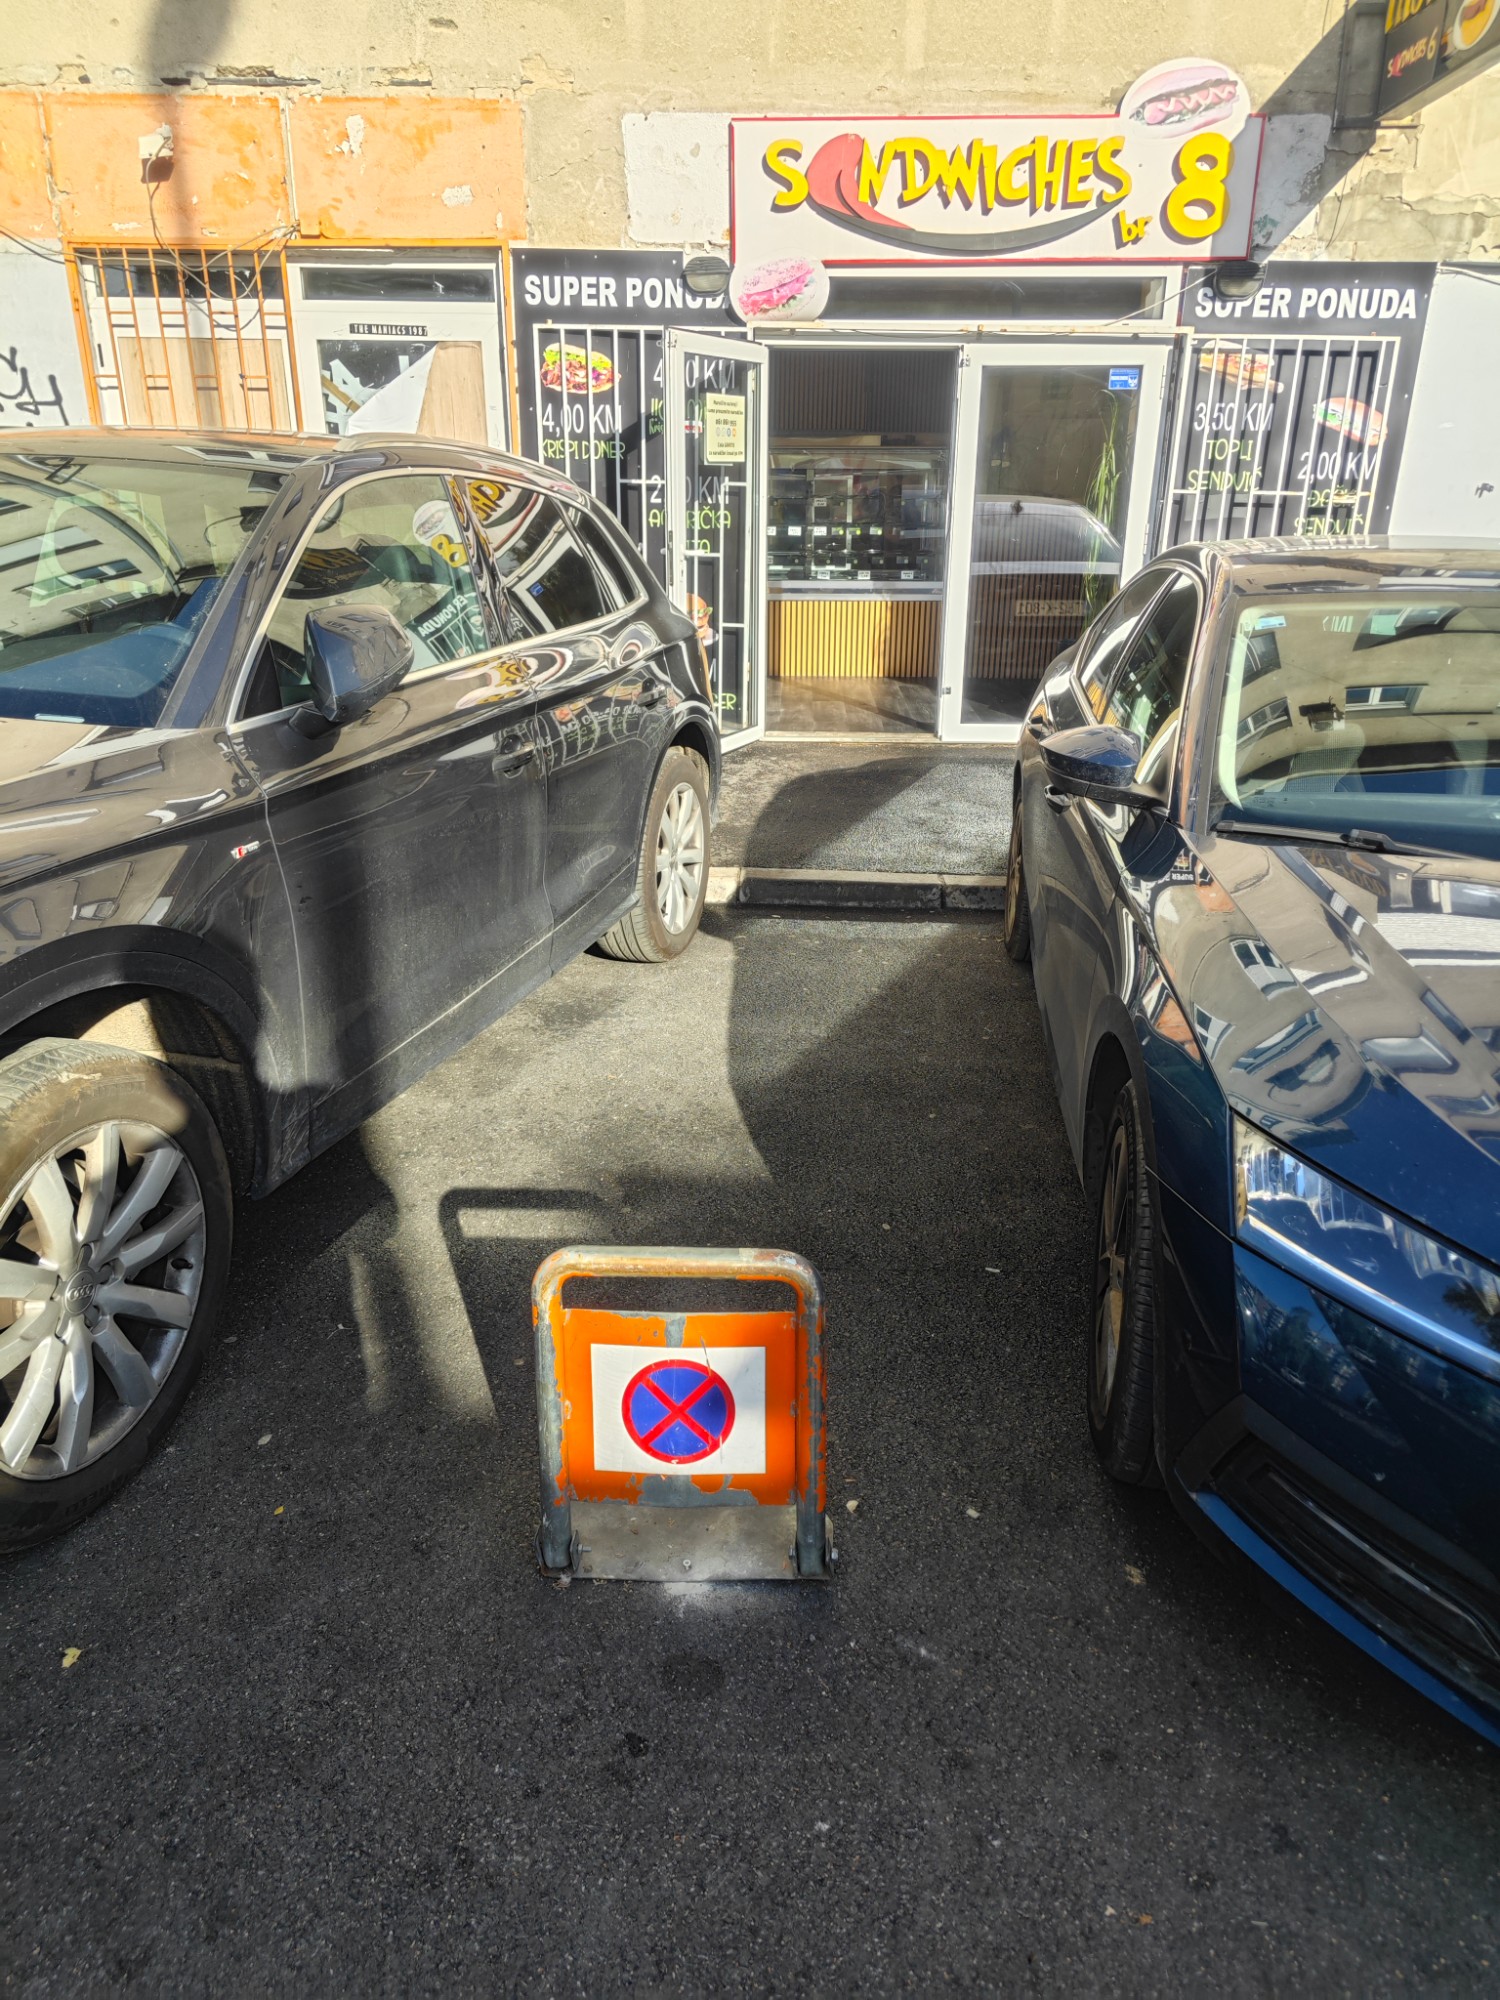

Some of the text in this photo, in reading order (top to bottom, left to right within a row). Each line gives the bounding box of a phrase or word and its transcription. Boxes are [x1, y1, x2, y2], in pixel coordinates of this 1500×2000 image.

[1119, 132, 1233, 243] br 8
[524, 274, 618, 308] SUPER
[1298, 287, 1417, 319] PONUDA
[354, 324, 369, 333] THE
[704, 358, 735, 389] KM
[542, 403, 585, 438] 4,00
[593, 404, 623, 434] KM
[1241, 402, 1275, 431] KM
[1206, 438, 1254, 461] TOPLI
[1188, 466, 1263, 492] SENDVIČ
[1297, 451, 1342, 485] 2,00
